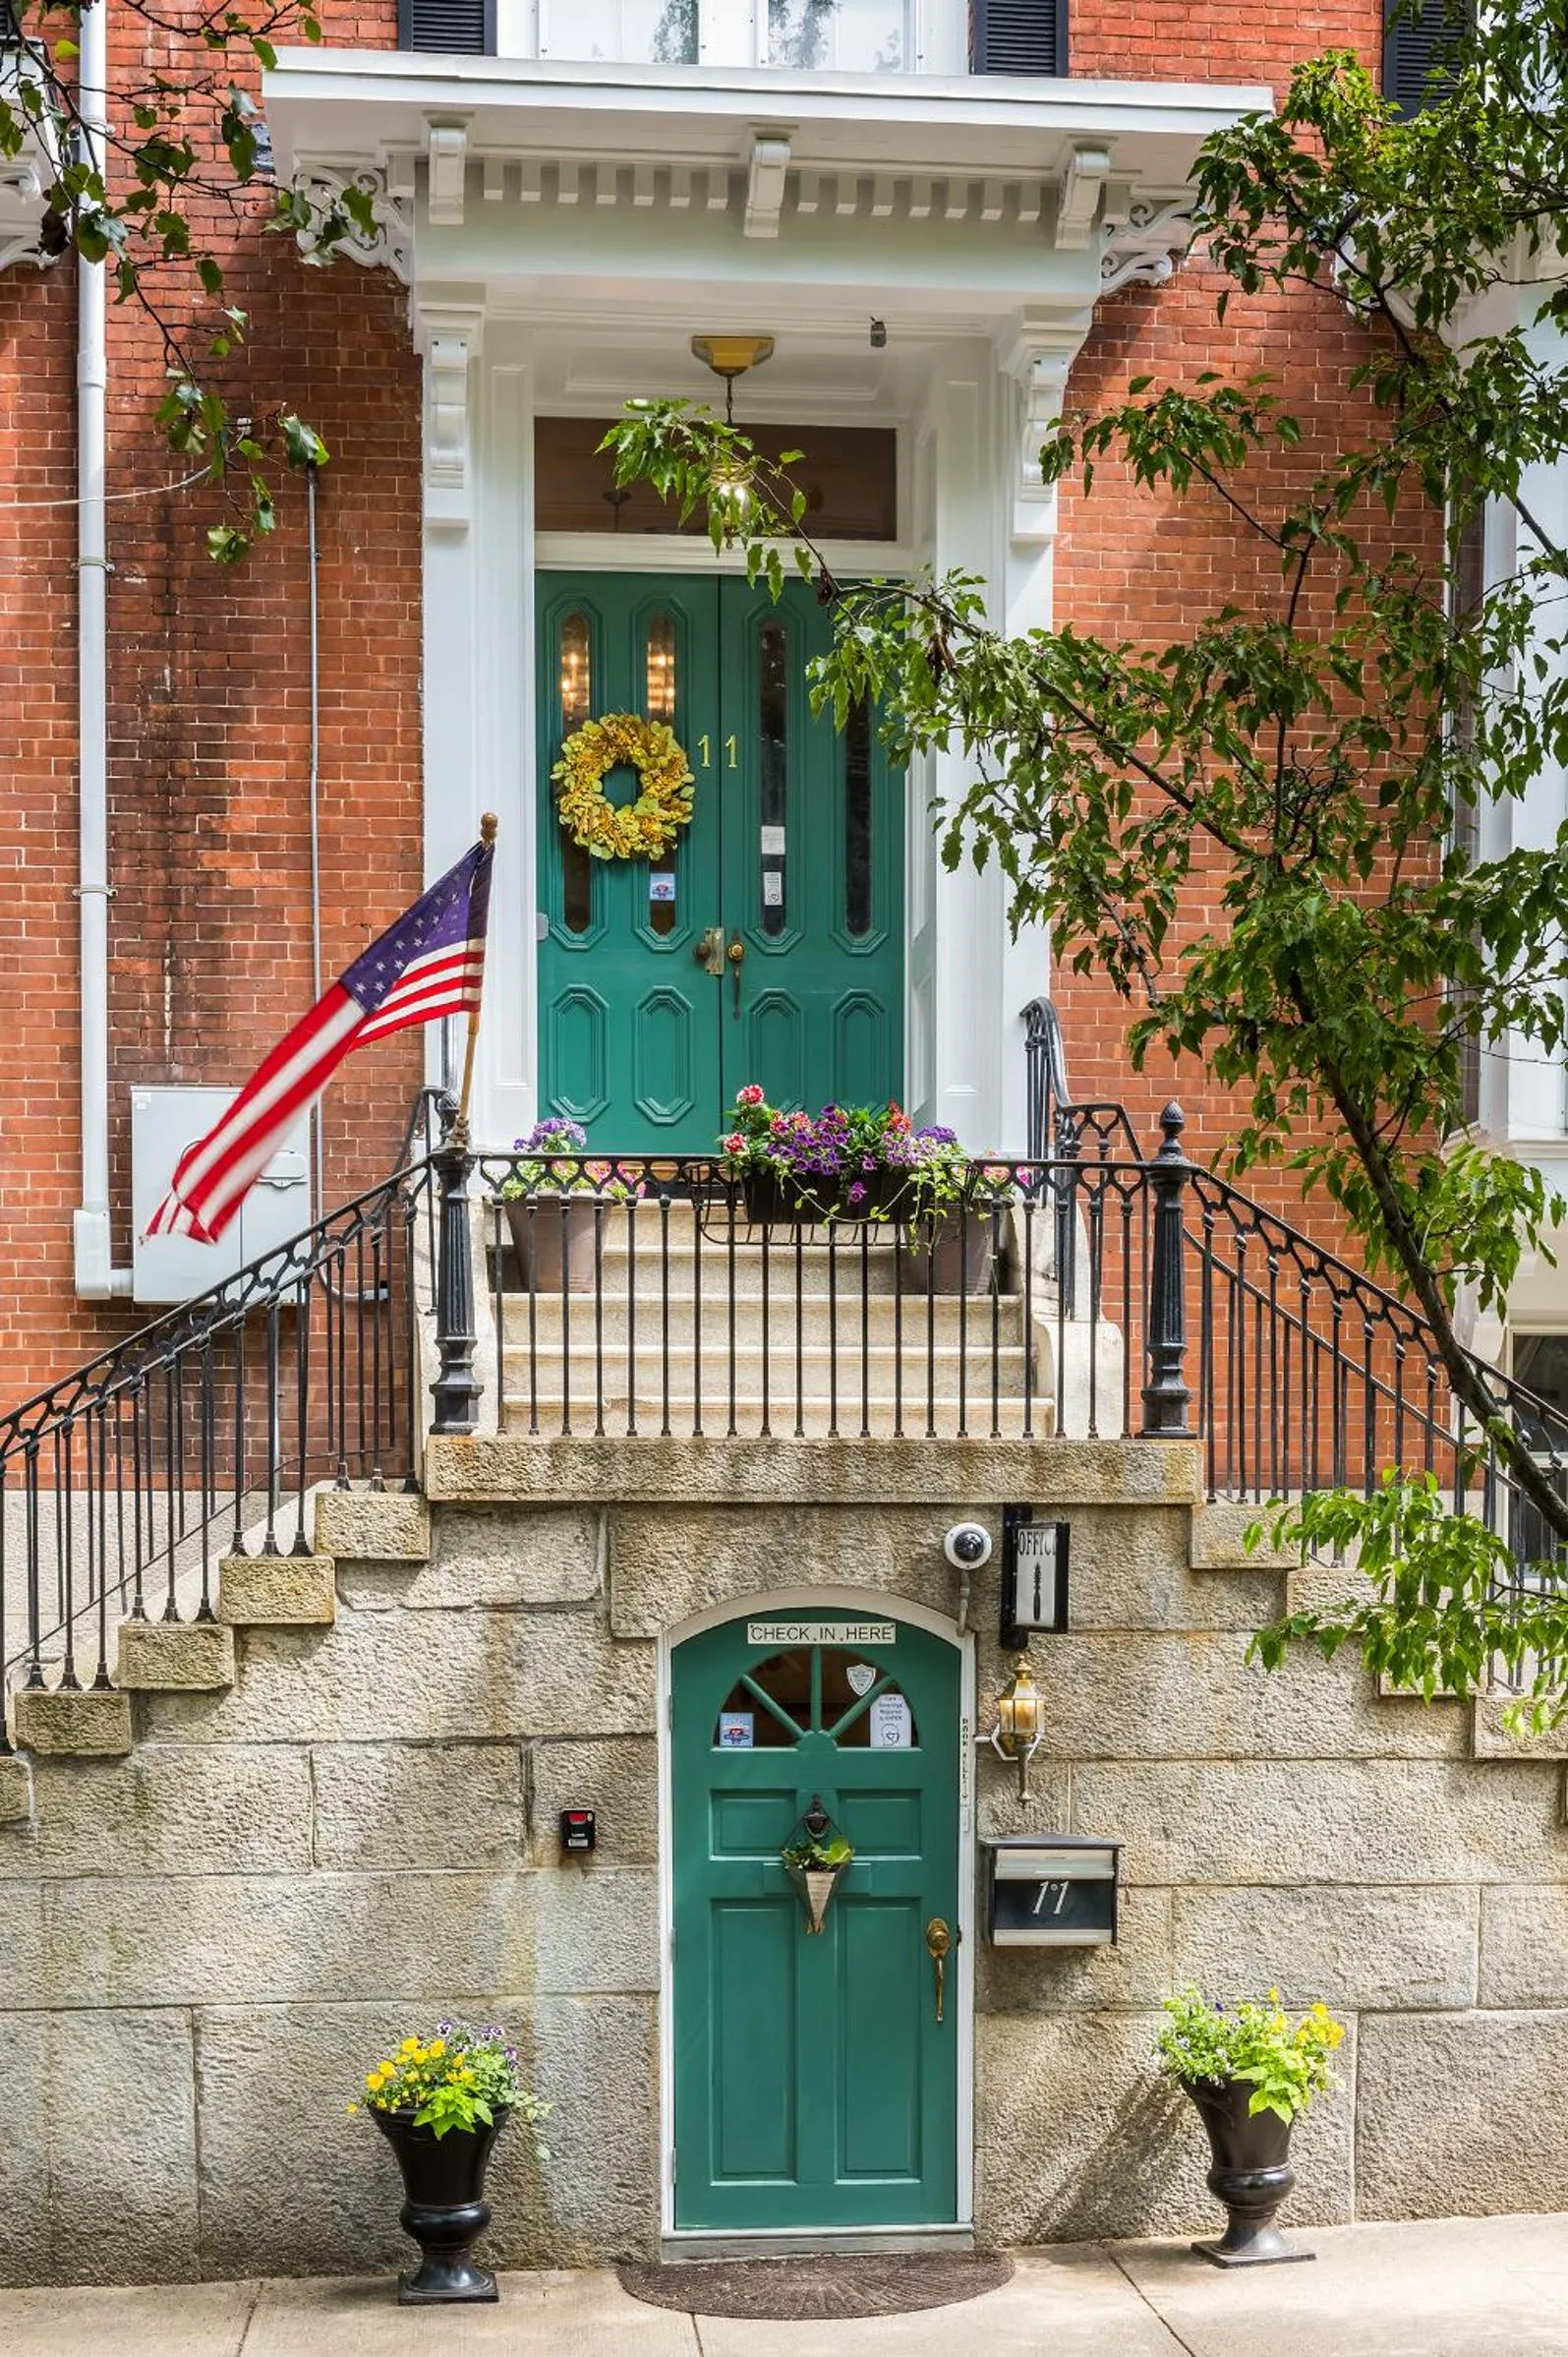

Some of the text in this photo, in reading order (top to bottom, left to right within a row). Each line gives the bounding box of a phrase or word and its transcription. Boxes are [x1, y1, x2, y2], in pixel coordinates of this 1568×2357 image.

[697, 735, 738, 768] 11
[1018, 1531, 1056, 1556] OFFIC
[751, 1625, 892, 1641] CHECK IN HERE
[1032, 1880, 1070, 1915] 11
